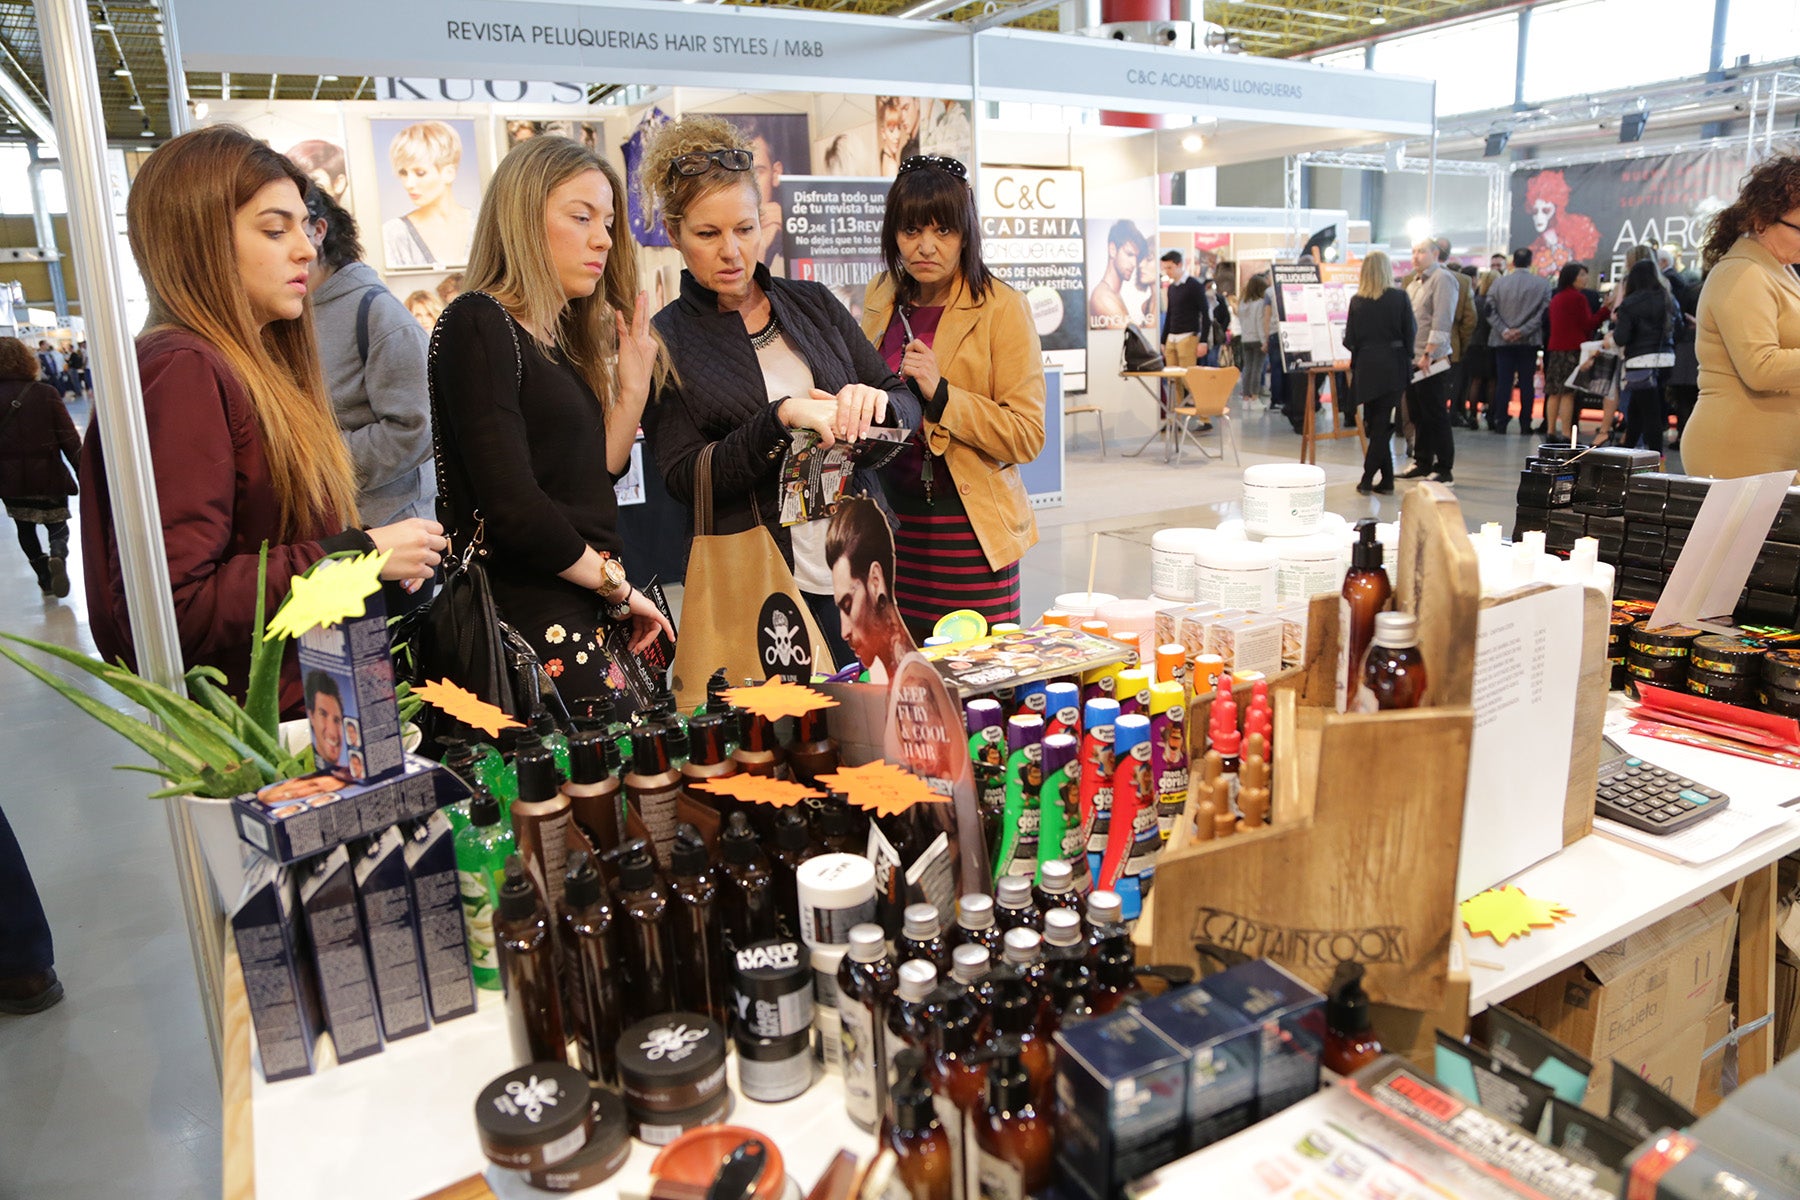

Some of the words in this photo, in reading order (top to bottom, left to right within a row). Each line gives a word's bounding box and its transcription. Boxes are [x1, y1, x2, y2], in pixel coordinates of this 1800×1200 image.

[447, 21, 525, 43] REVISTA
[532, 26, 658, 50] PELUQUERIAS
[665, 34, 707, 52] HAIR
[713, 36, 768, 55] STYLES
[785, 40, 824, 57] M&B
[1126, 69, 1157, 85] C&C
[1161, 72, 1230, 92] ACADEMIAS
[1233, 79, 1303, 99] LLONGUERAS
[793, 191, 839, 203] Disfruta
[841, 191, 868, 203] todo
[870, 193, 885, 203] un
[994, 176, 1056, 210] C&C
[792, 203, 808, 214] de
[809, 204, 823, 214] tu
[825, 203, 862, 214] revista
[864, 203, 887, 214] favo
[983, 218, 1081, 236] CADEMIA
[795, 236, 809, 245] No
[811, 236, 834, 247] dejes
[835, 238, 852, 247] que
[853, 236, 863, 245] te
[864, 235, 873, 244] lo
[858, 246, 882, 254] nosot
[1013, 266, 1026, 277] DE
[1027, 265, 1082, 278] ENSEÑANZA
[897, 686, 927, 702] KEEP
[897, 705, 928, 722] FURY
[903, 742, 937, 760] HAIR
[736, 942, 799, 962] HARD
[738, 953, 799, 970] MATT
